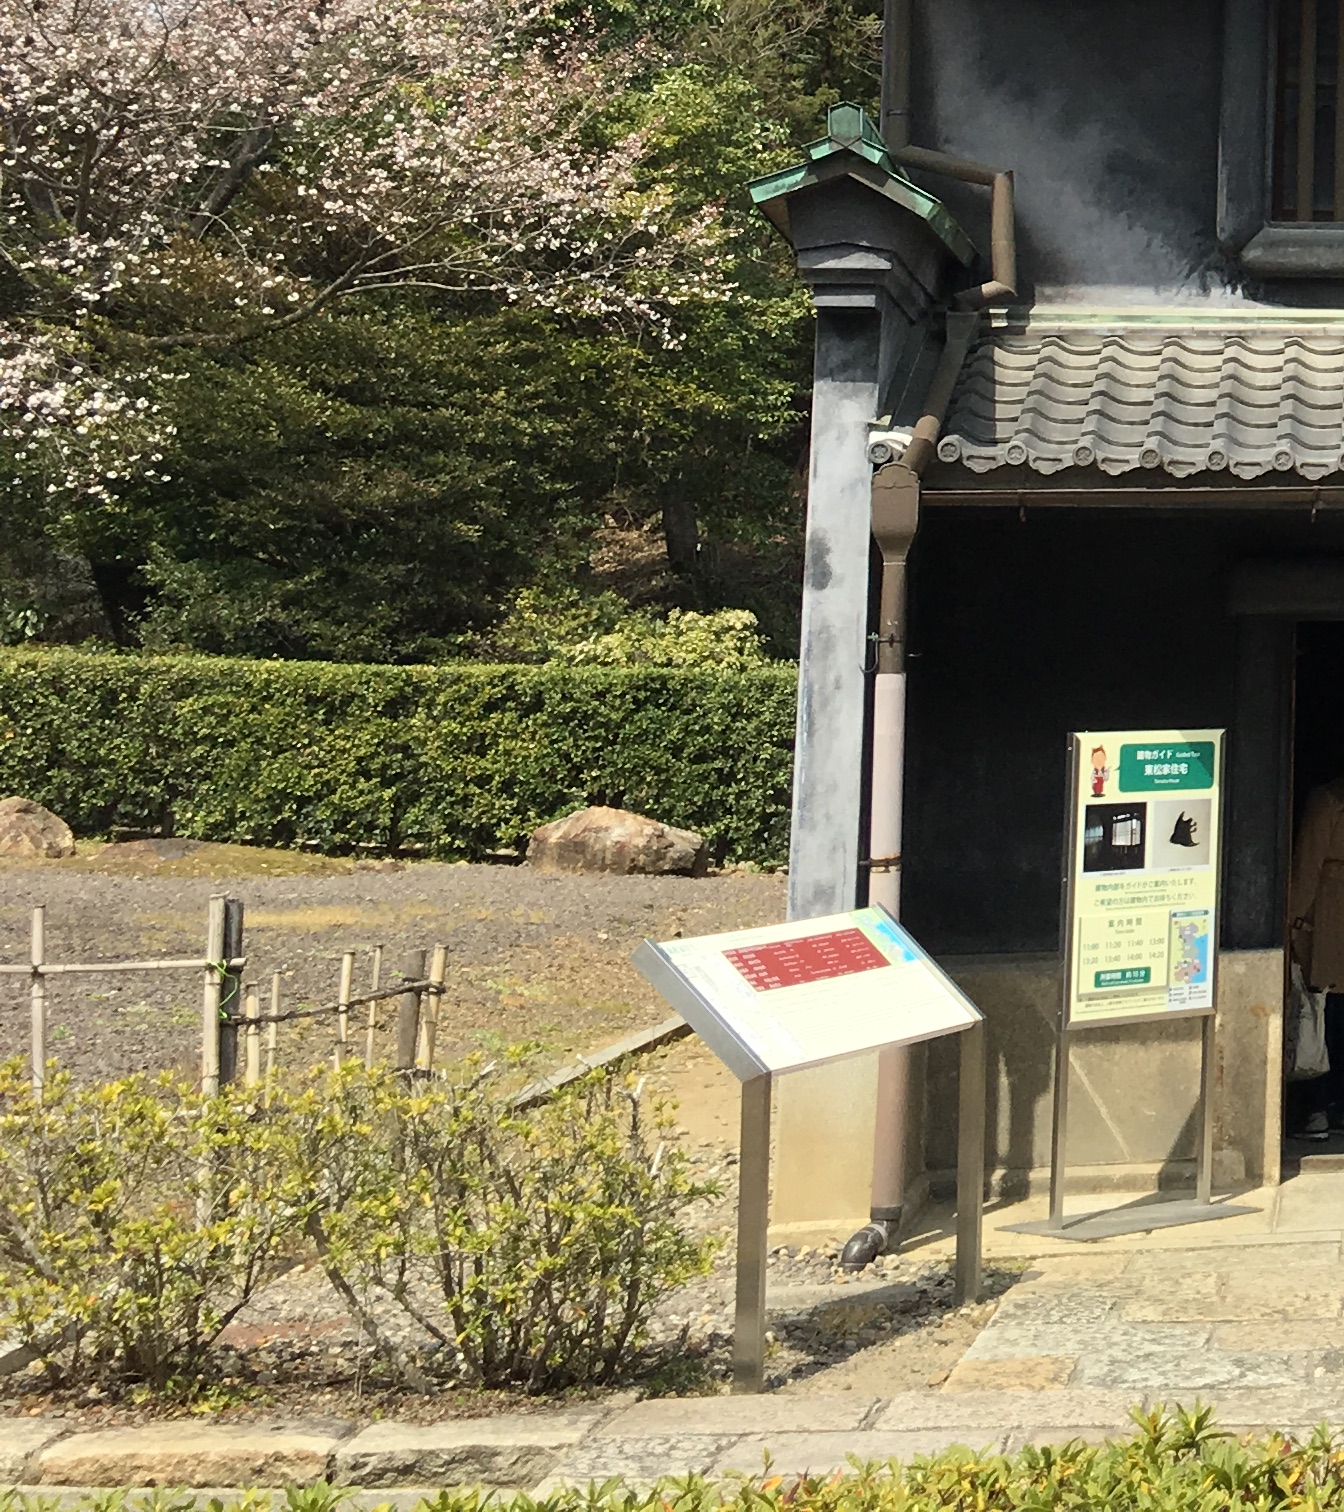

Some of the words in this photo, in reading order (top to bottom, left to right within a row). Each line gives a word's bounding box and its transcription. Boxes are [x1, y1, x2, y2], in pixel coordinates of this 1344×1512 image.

[1136, 750, 1174, 761] 建物ガイド
[1144, 764, 1189, 776] 東松家住宅
